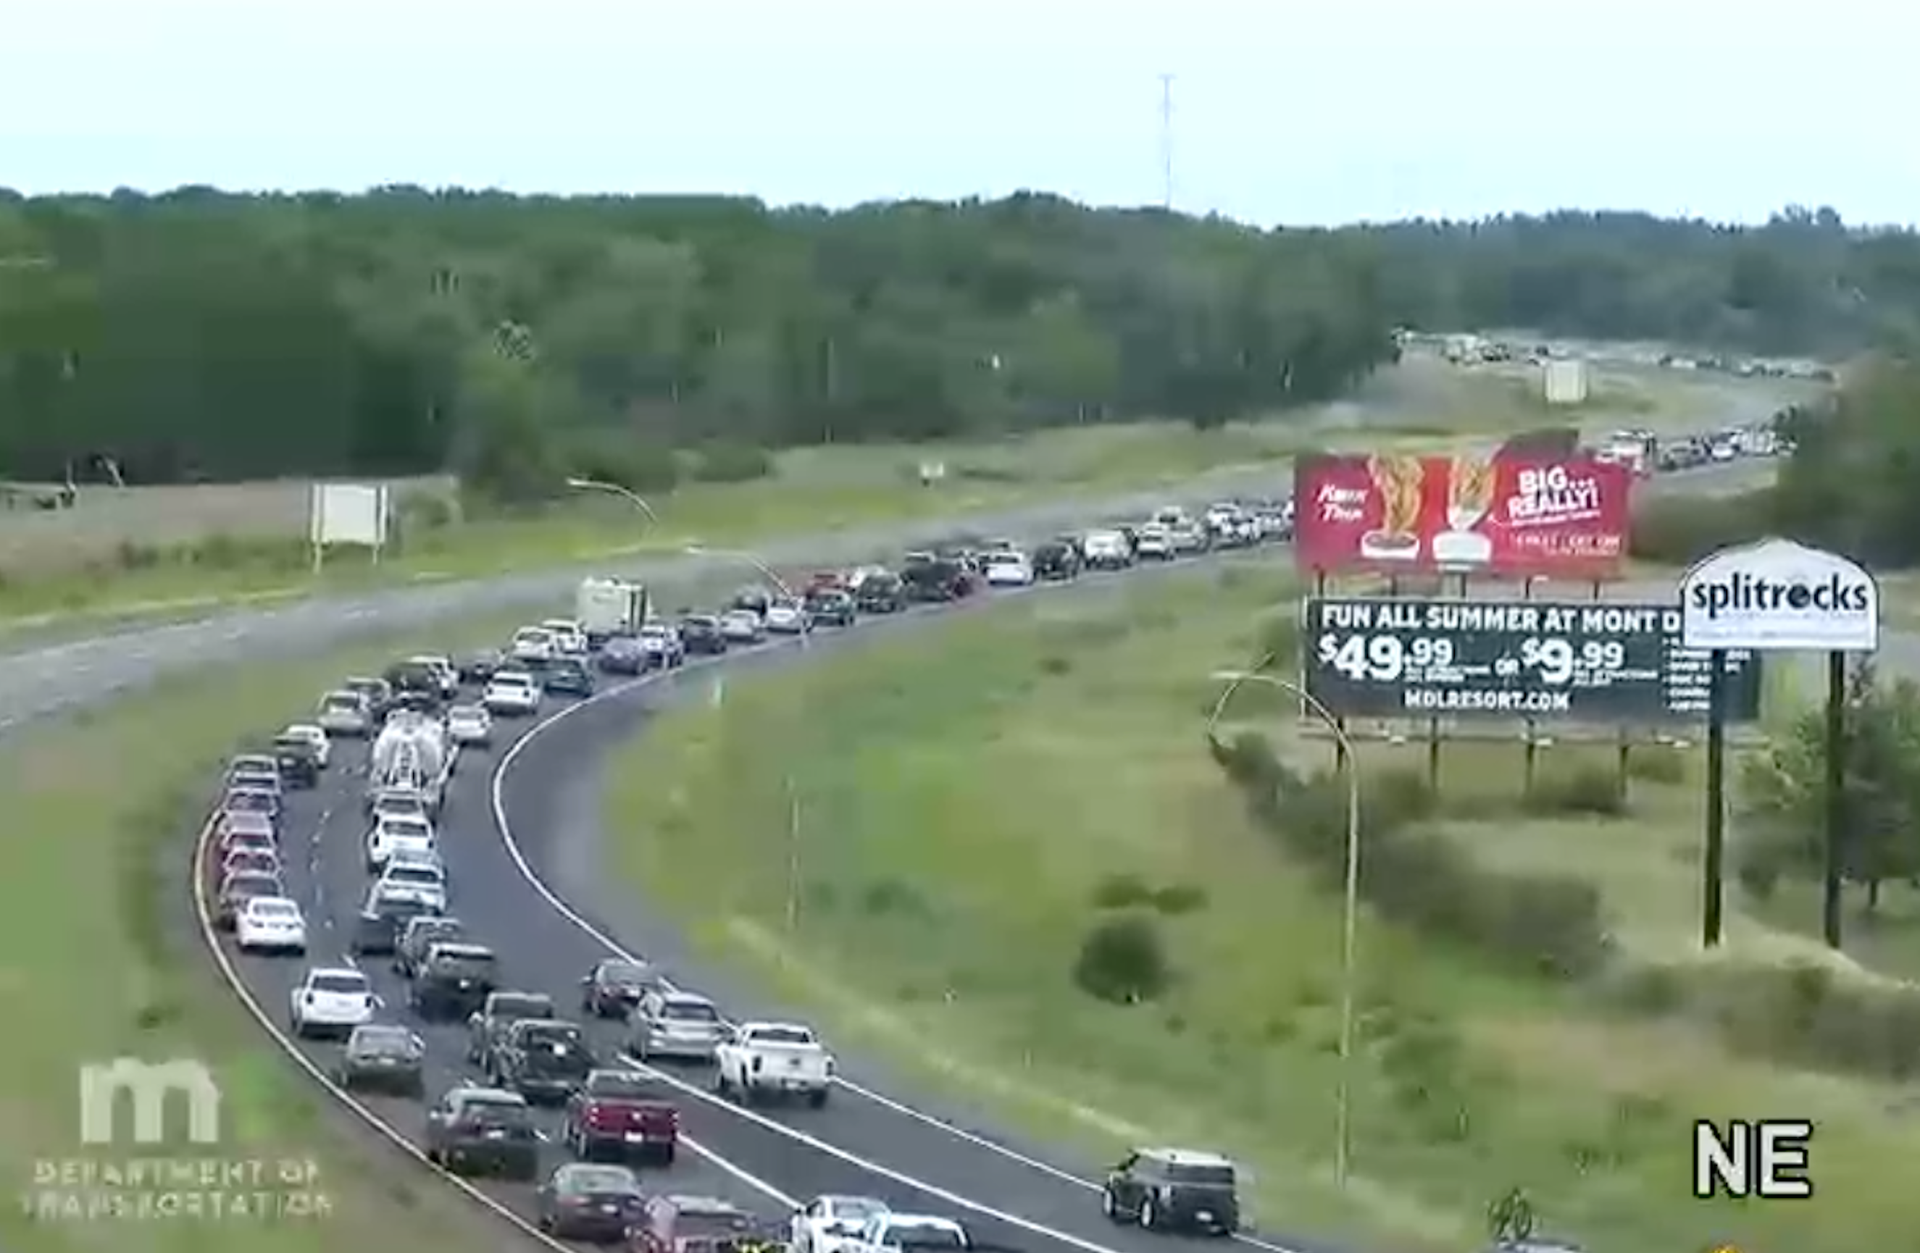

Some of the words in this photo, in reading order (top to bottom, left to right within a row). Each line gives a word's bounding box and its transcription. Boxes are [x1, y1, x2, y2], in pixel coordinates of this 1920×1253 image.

[1519, 465, 1595, 494] BIG...
[1507, 487, 1600, 518] REALLY!
[1692, 572, 1868, 618] splitrocks
[1322, 604, 1371, 629] FUN
[1375, 604, 1421, 629] ALL
[1425, 605, 1538, 631] SUMMER
[1544, 607, 1577, 632] AT
[1582, 608, 1657, 633] MONT
[1494, 658, 1519, 676] OR
[1404, 690, 1570, 711] MDLRESORT.COM
